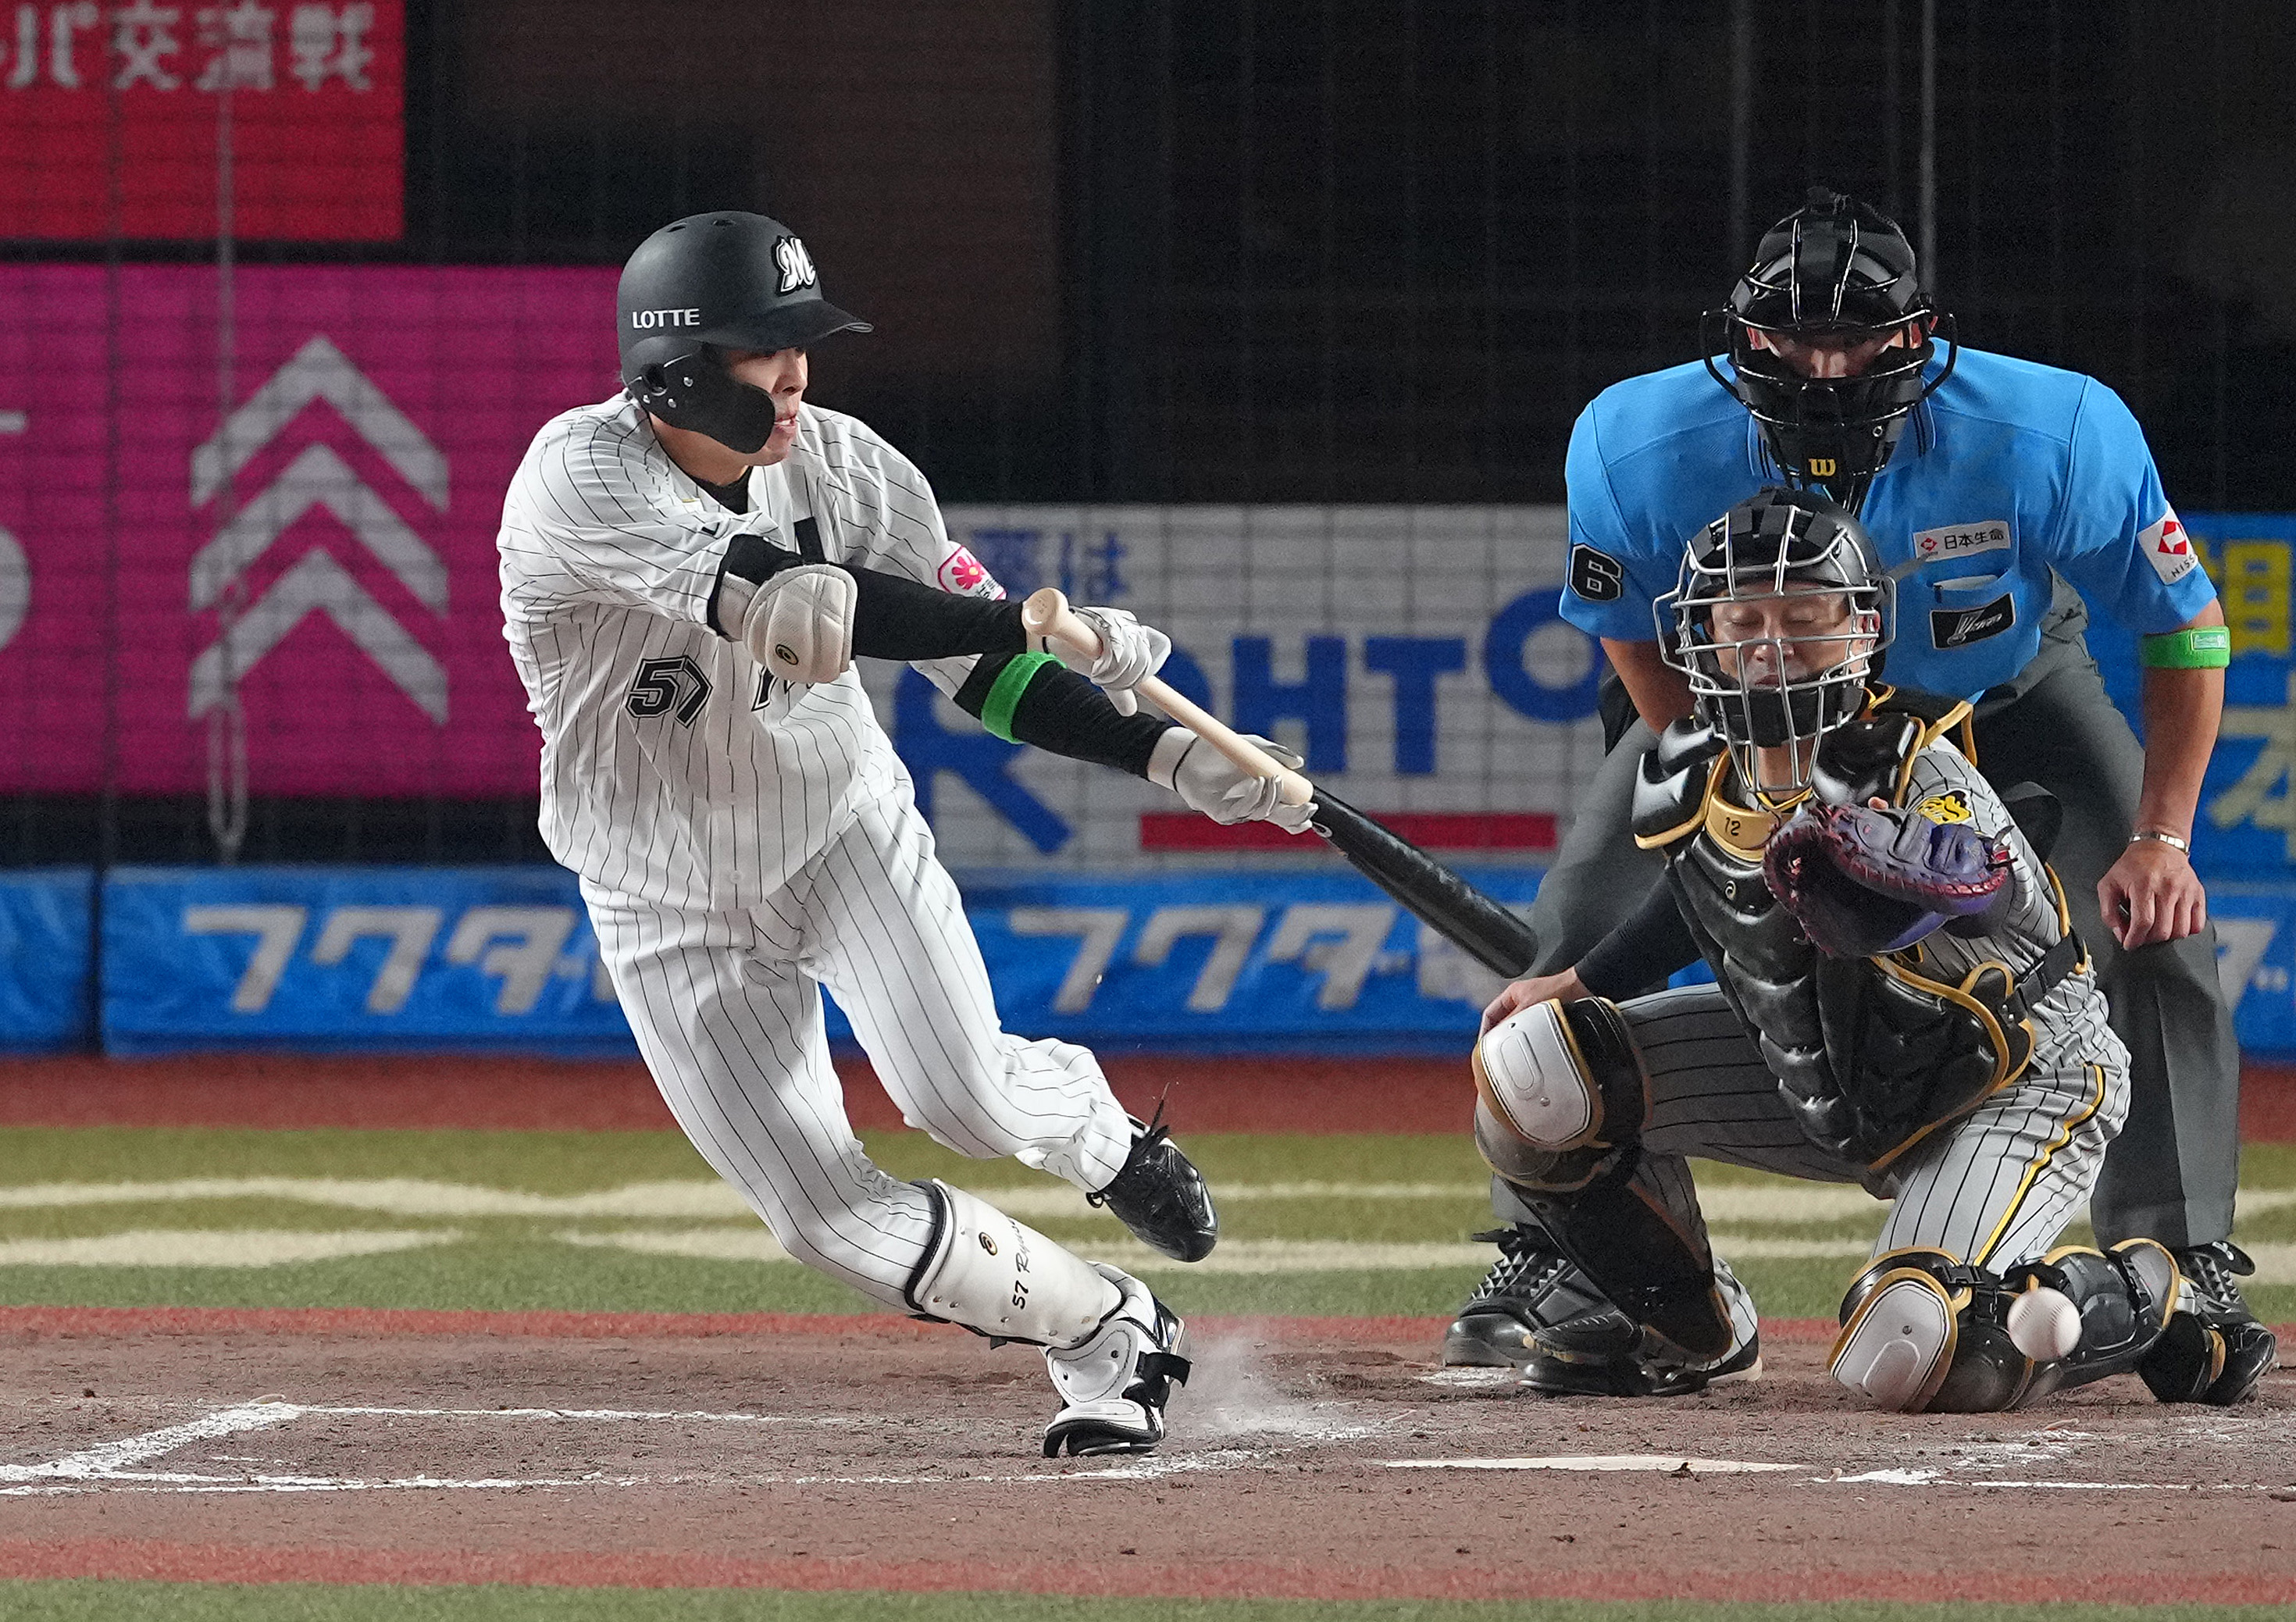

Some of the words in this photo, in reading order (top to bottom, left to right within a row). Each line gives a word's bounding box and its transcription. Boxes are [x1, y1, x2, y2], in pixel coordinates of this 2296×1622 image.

[632, 308, 701, 329] LOTTE
[1944, 528, 2004, 550] 日本生命
[1569, 544, 1622, 601] 6
[894, 587, 1603, 854] RHTO
[1724, 817, 1742, 836] 12
[1012, 1279, 1029, 1310] 57
